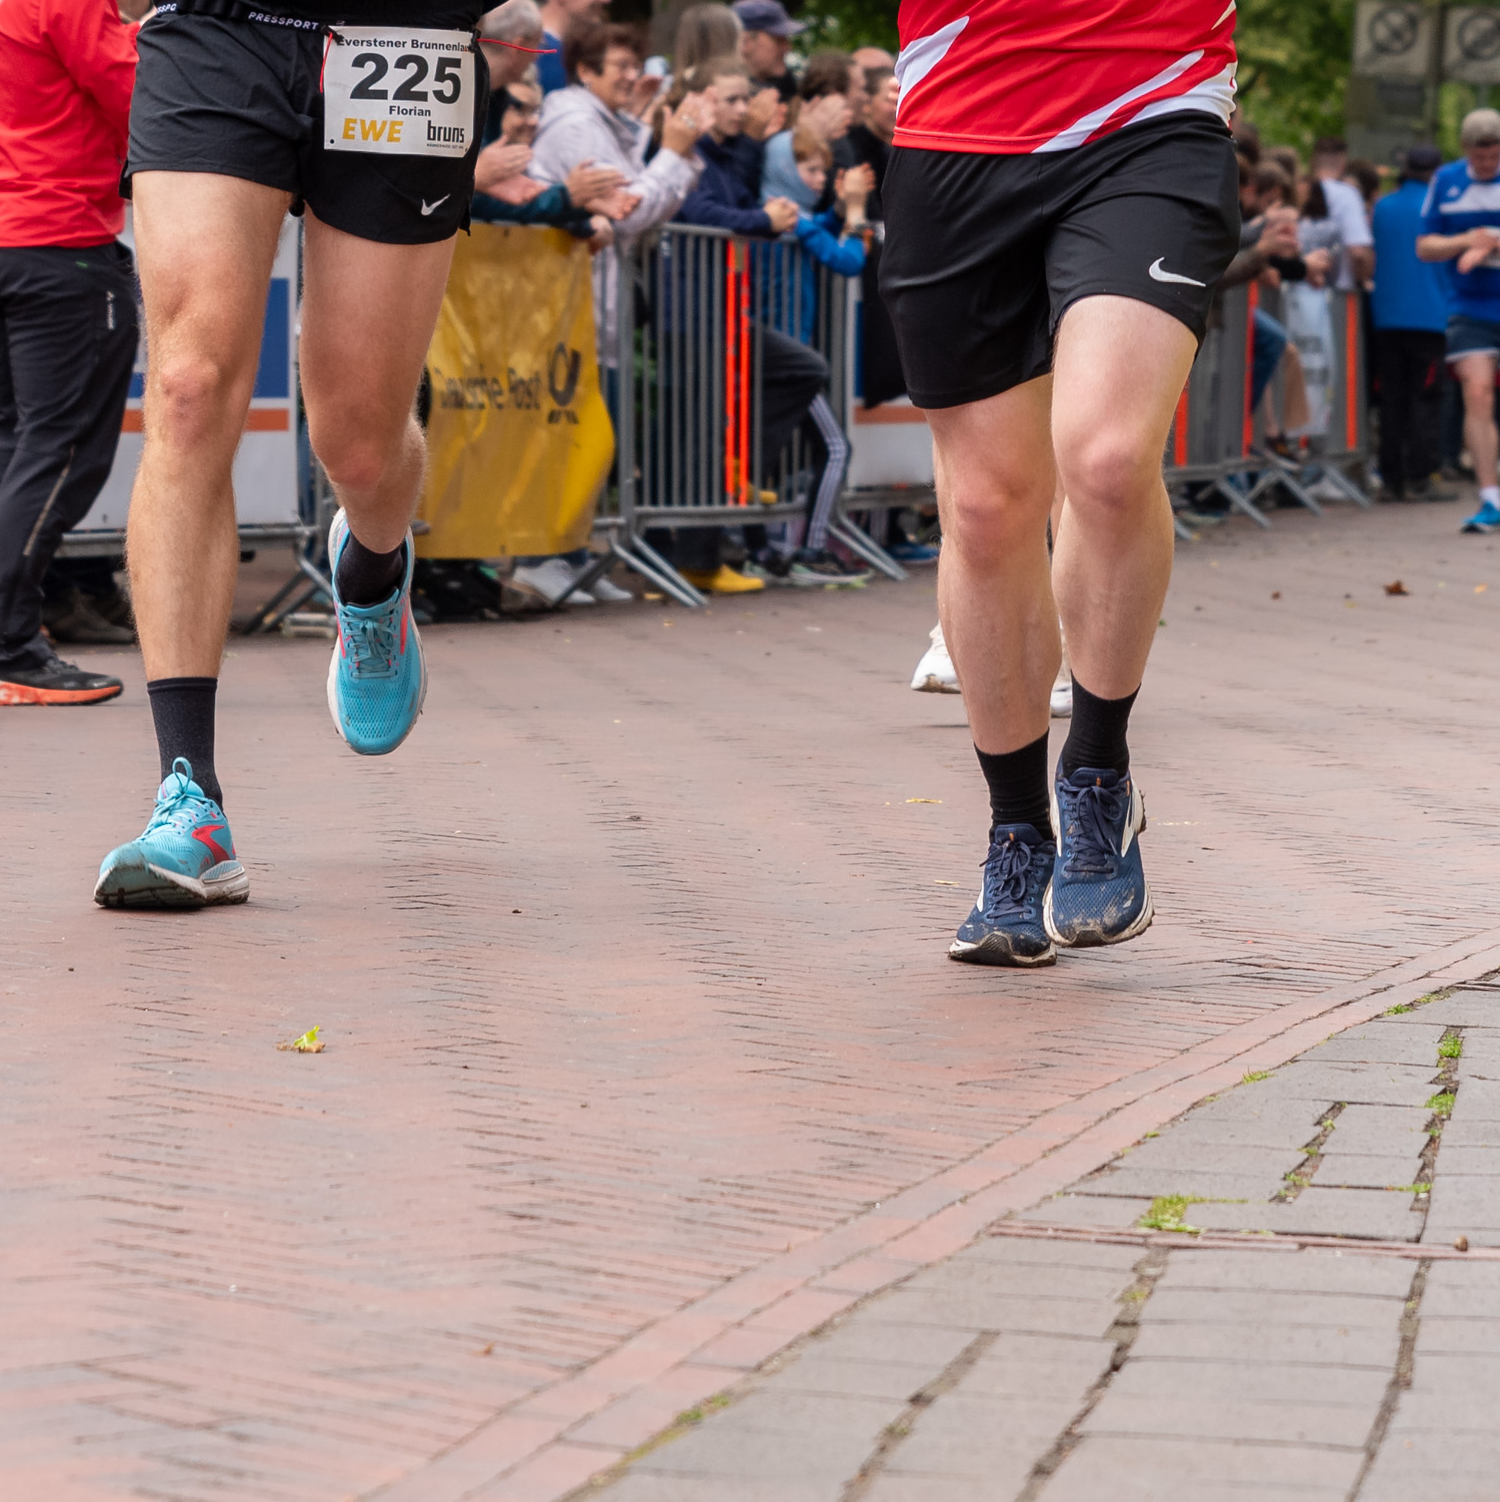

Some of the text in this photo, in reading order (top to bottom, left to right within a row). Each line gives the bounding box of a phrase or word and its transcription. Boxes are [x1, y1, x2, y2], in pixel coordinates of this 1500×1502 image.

[248, 11, 319, 30] PRESSPORT
[337, 36, 472, 52] Everstener Brunnenla
[350, 52, 462, 104] 225
[389, 105, 431, 117] Florian
[342, 118, 465, 143] EWE bruns
